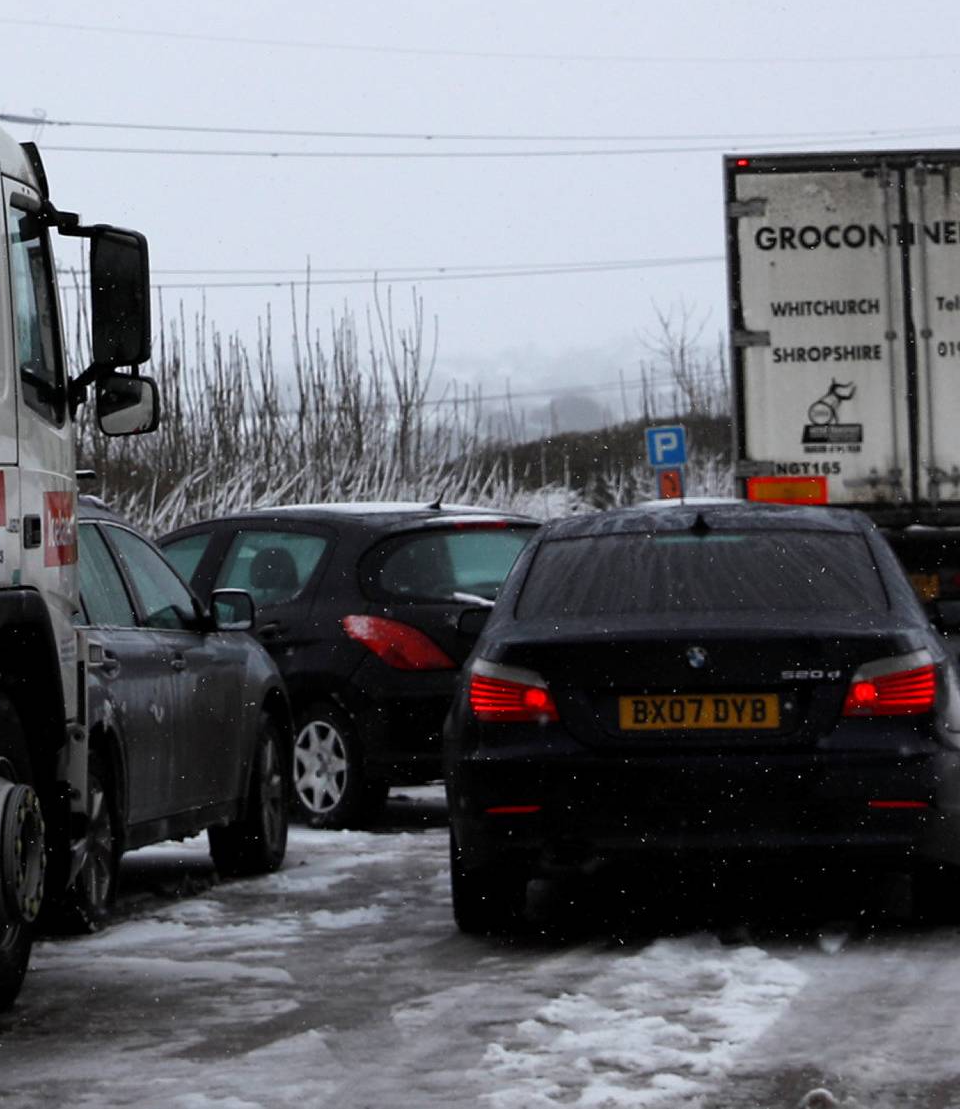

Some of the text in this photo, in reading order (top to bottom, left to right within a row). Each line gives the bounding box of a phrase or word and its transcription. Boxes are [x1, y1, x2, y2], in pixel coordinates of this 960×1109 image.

[755, 221, 960, 251] GROCONTINE
[771, 298, 880, 317] WHITCHURCH
[773, 344, 882, 363] SHROPSHIRE
[655, 432, 677, 462] P
[632, 698, 767, 724] BX07 DYB
